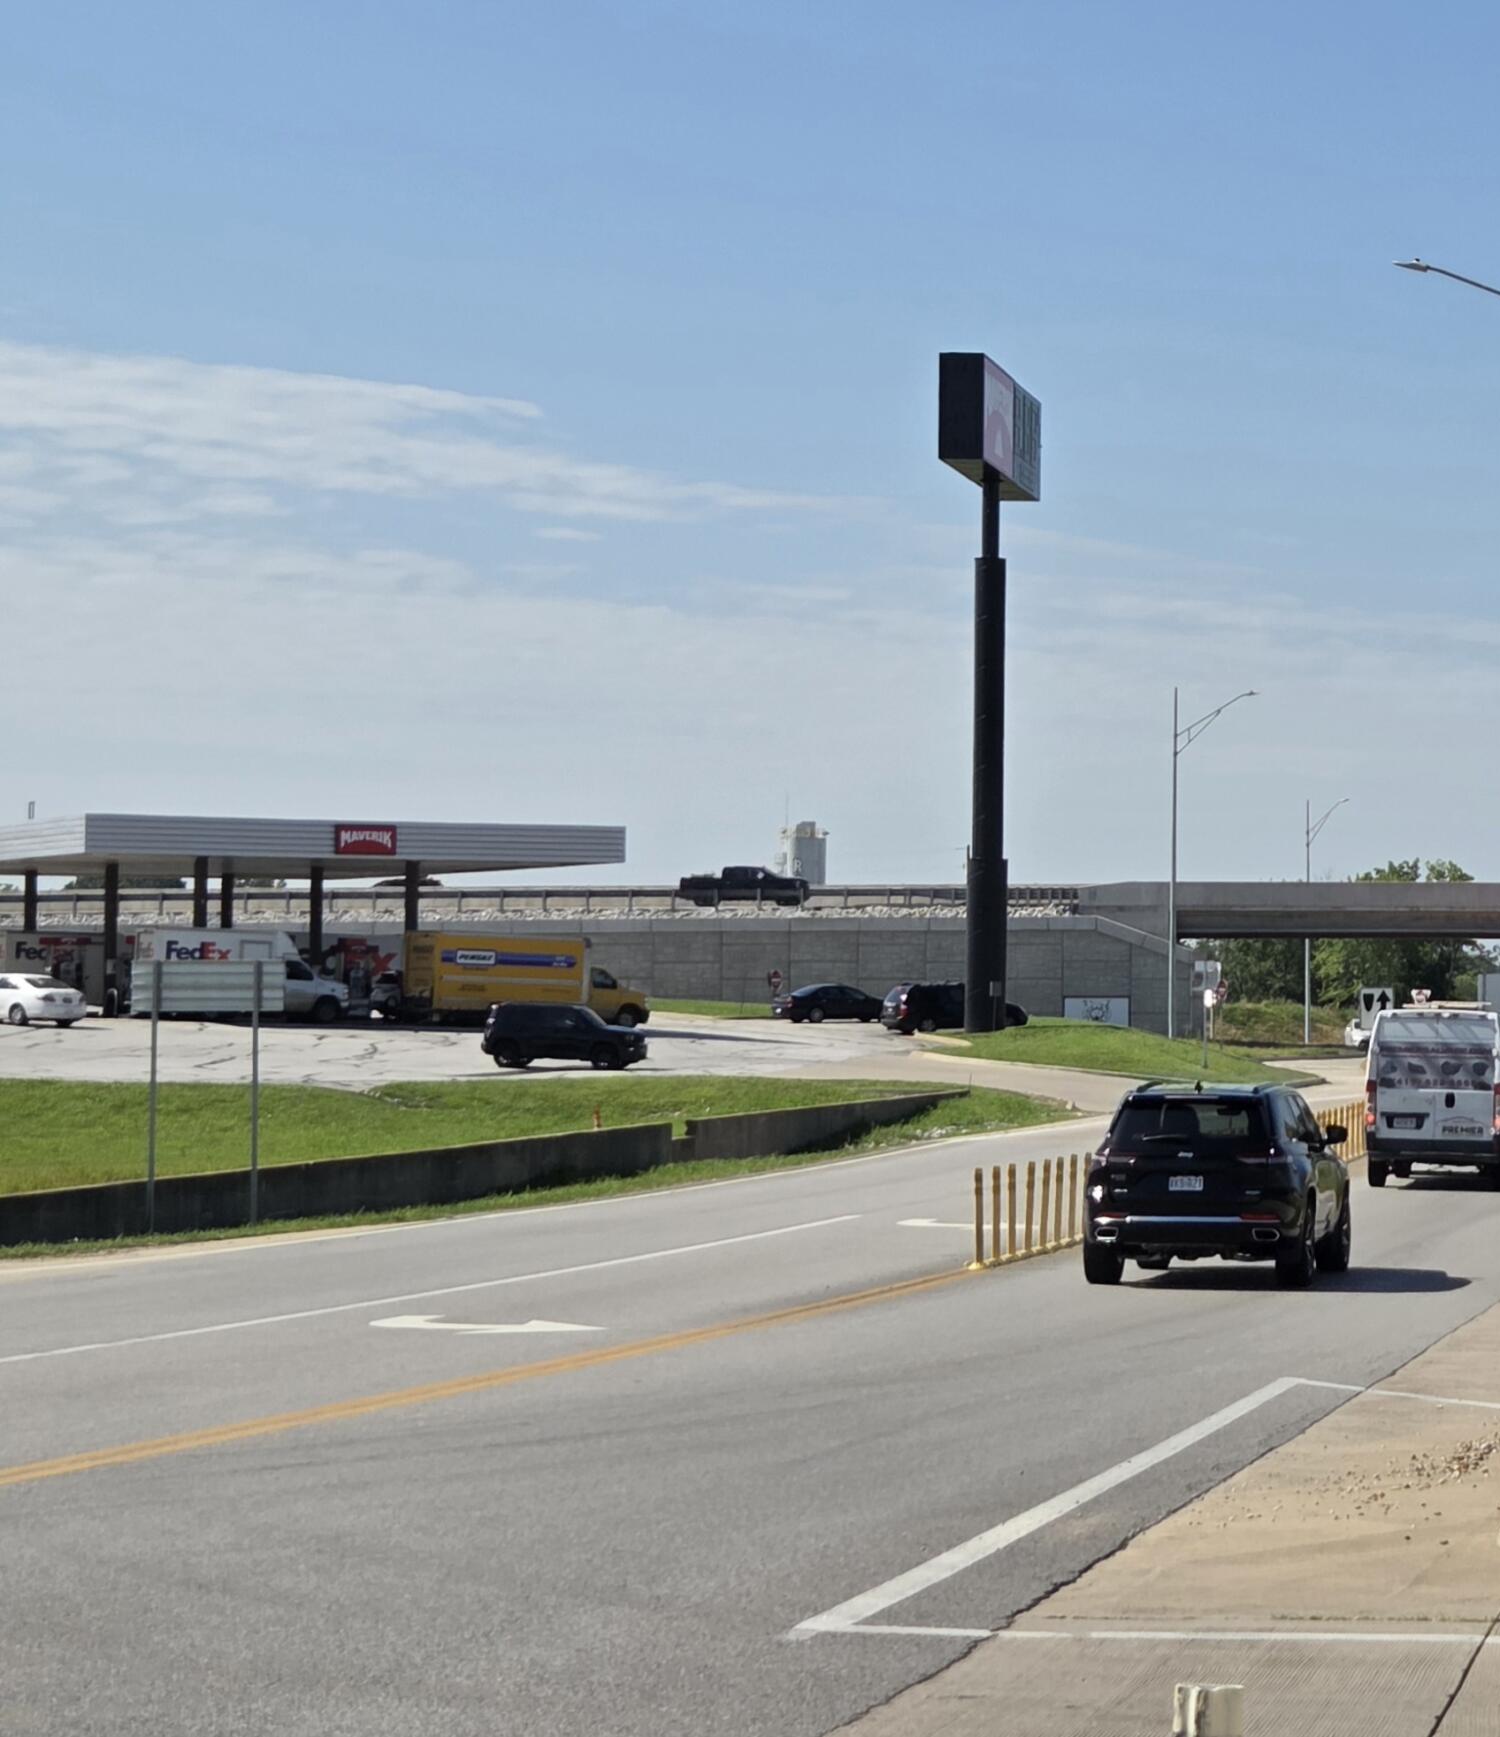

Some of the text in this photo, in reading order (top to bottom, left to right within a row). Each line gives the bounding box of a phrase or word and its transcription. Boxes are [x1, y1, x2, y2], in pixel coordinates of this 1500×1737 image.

[340, 829, 393, 848] MAVERIK
[165, 940, 231, 960] FedEx
[1442, 1125, 1484, 1136] PREMIER
